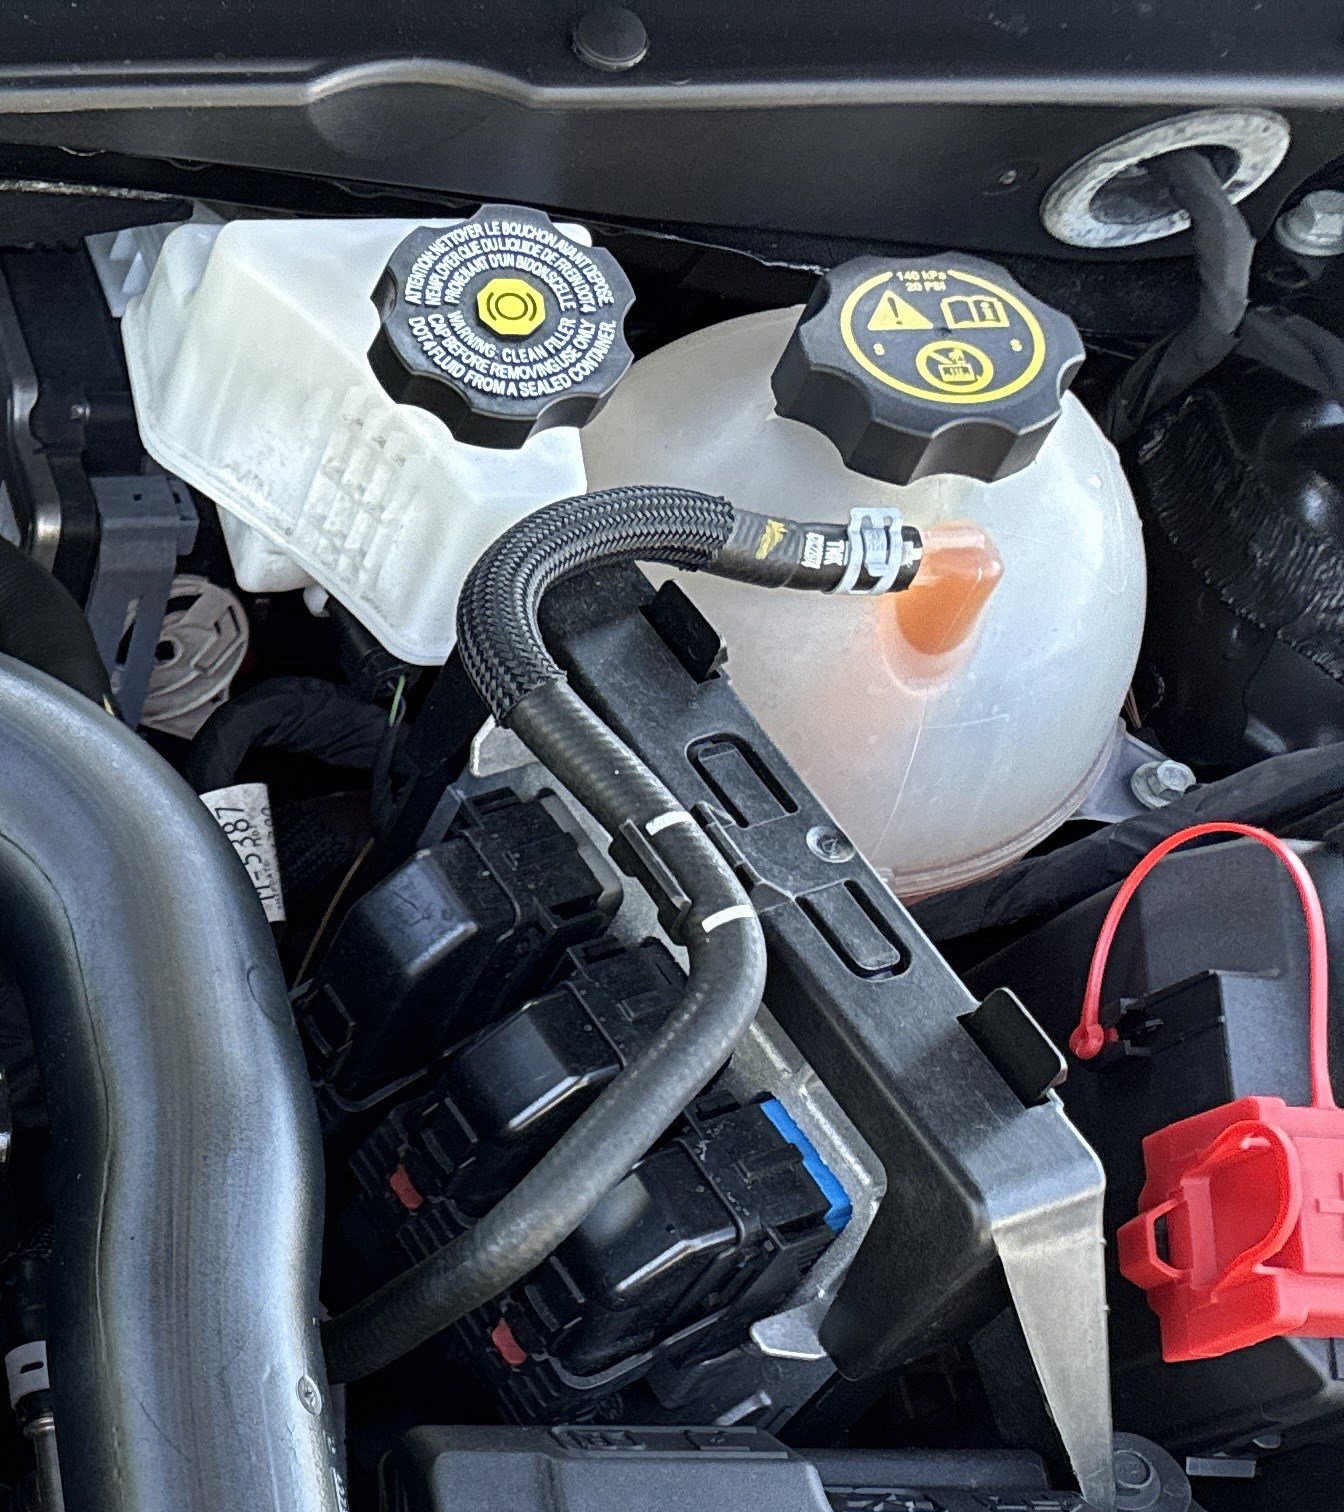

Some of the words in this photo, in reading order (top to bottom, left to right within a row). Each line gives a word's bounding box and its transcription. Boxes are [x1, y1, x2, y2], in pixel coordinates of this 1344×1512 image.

[430, 223, 485, 255] NETTOYER
[485, 220, 501, 235] LE
[502, 222, 559, 246] BOUCHON
[556, 240, 593, 271] AVANT
[459, 241, 483, 259] QUE
[483, 238, 499, 252] DU
[499, 236, 547, 257] LIQUIDE
[554, 258, 585, 286] FREIN
[444, 255, 489, 303] PROVENANT
[896, 271, 920, 281] 140
[905, 281, 922, 291] 20
[428, 314, 451, 343] CAP
[442, 335, 491, 373] BEFORE
[554, 345, 582, 367] USE
[573, 318, 597, 350] ONLY
[448, 310, 499, 361] WARNING:
[502, 344, 550, 363] CLEAN
[544, 318, 577, 354] FILLER
[428, 346, 465, 378] FLUID
[464, 370, 505, 394] FROM
[505, 381, 518, 396] A
[519, 372, 572, 397] SEALED
